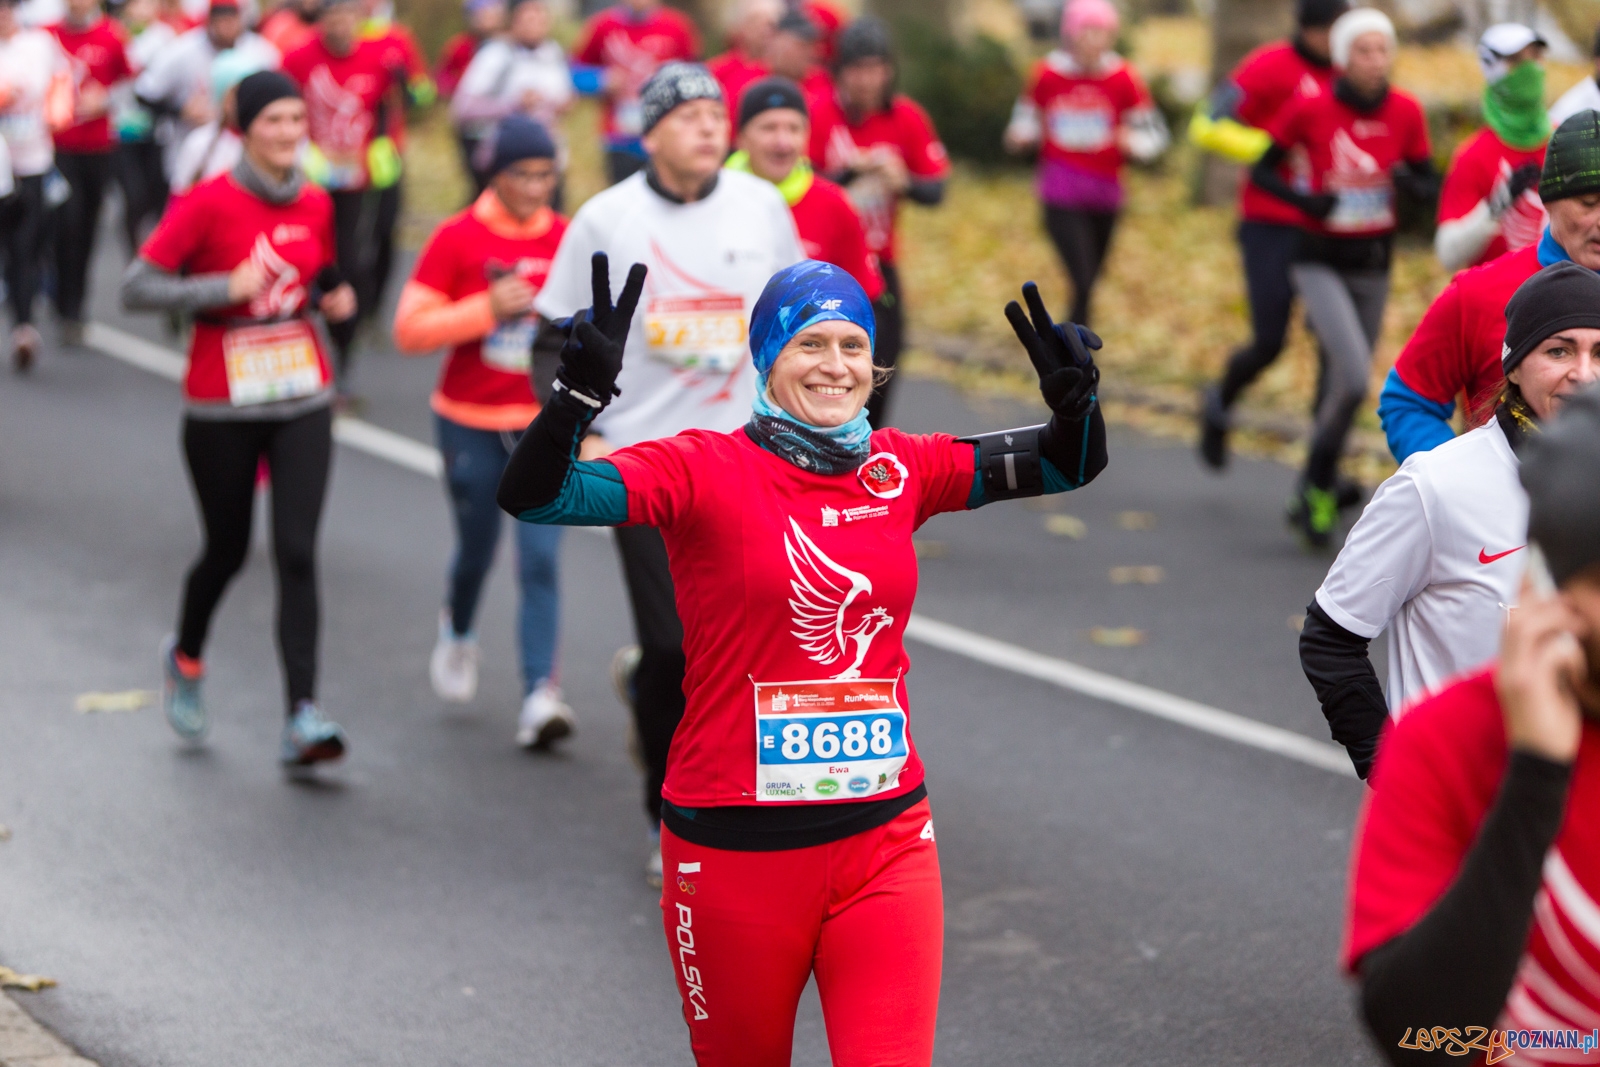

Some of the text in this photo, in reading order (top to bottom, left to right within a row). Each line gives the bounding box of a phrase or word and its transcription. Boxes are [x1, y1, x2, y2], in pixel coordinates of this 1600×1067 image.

[821, 299, 842, 310] 4F
[763, 718, 892, 760] E 8688
[765, 788, 796, 796] LUXMED
[675, 902, 709, 1021] POLSKA
